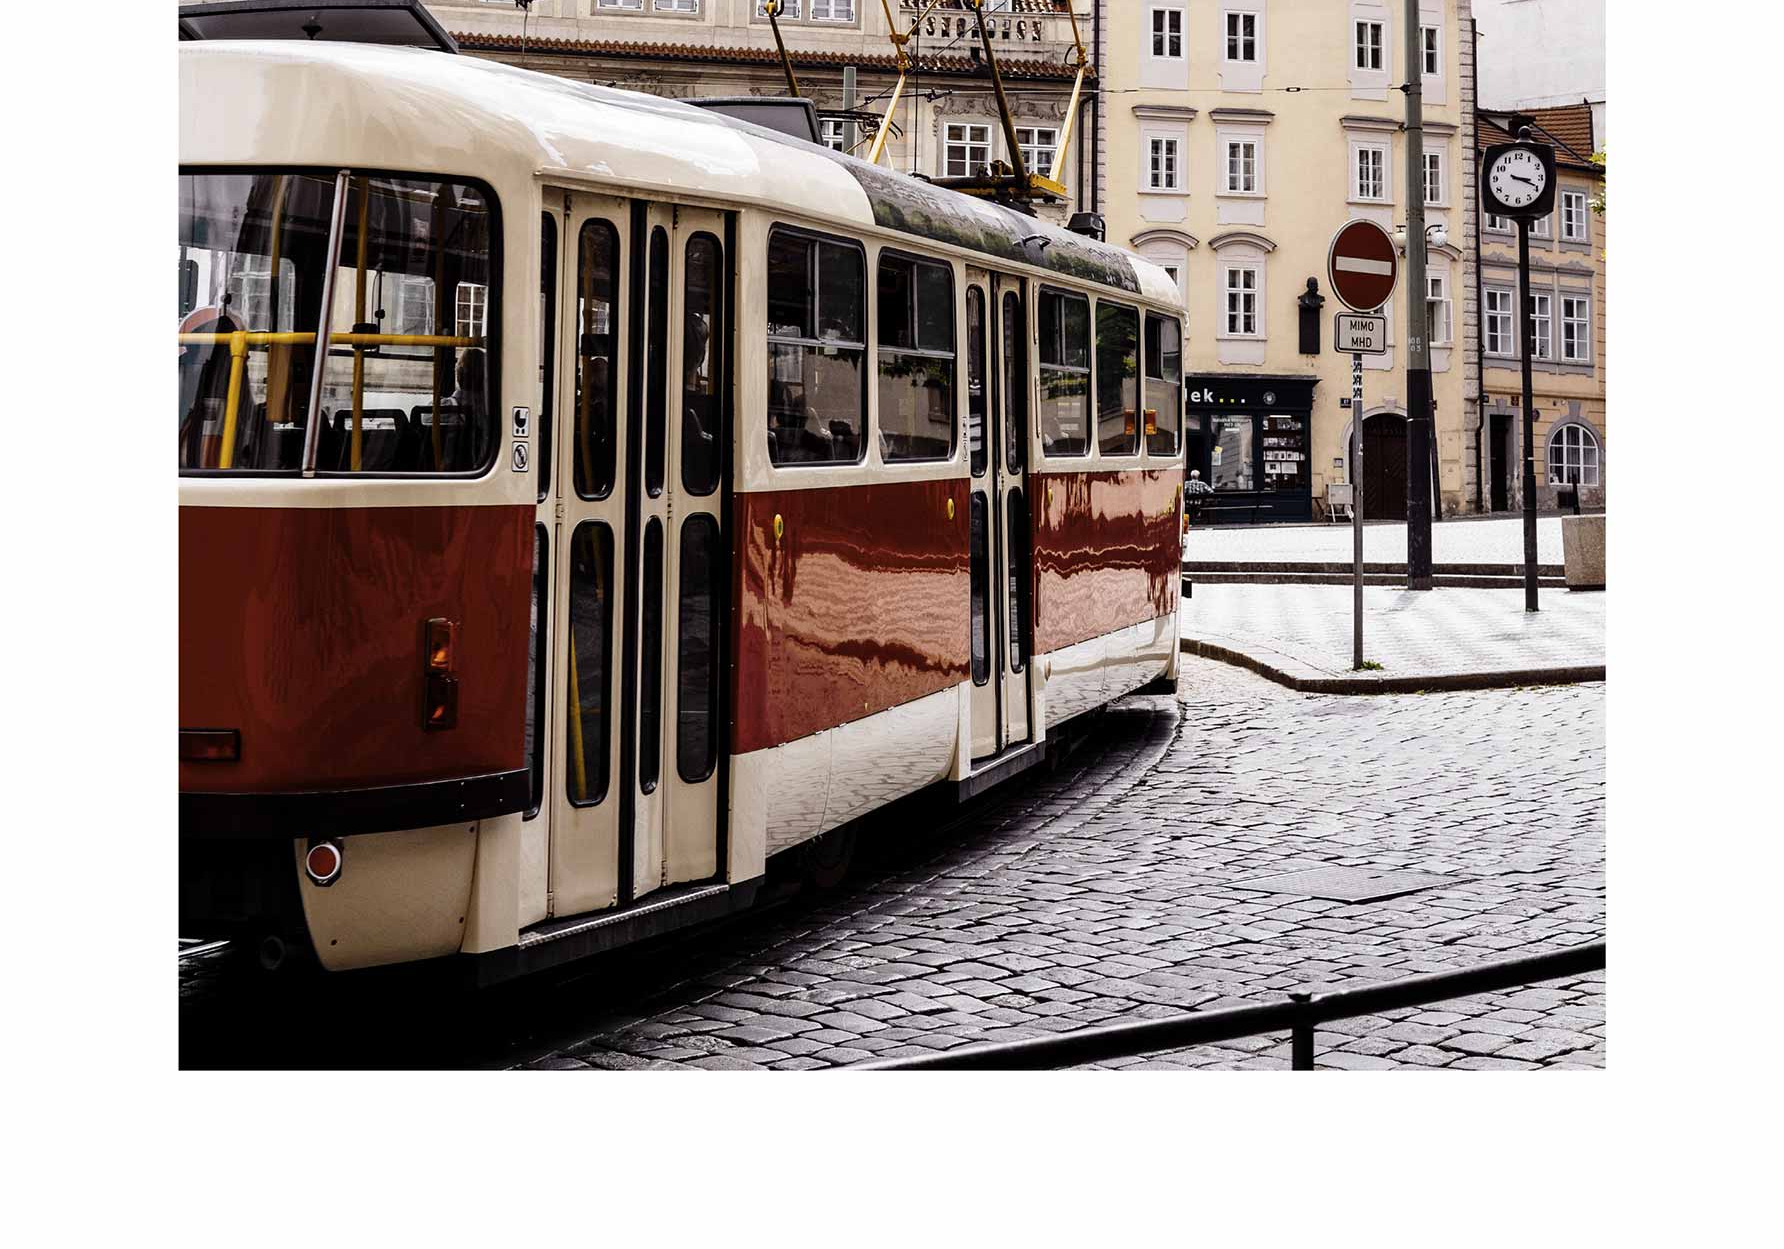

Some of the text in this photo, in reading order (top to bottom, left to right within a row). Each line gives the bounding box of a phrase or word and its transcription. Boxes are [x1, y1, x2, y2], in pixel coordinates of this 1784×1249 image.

[1504, 194, 1510, 202] 7
[1350, 320, 1374, 331] MIMO
[1351, 336, 1372, 348] MHD
